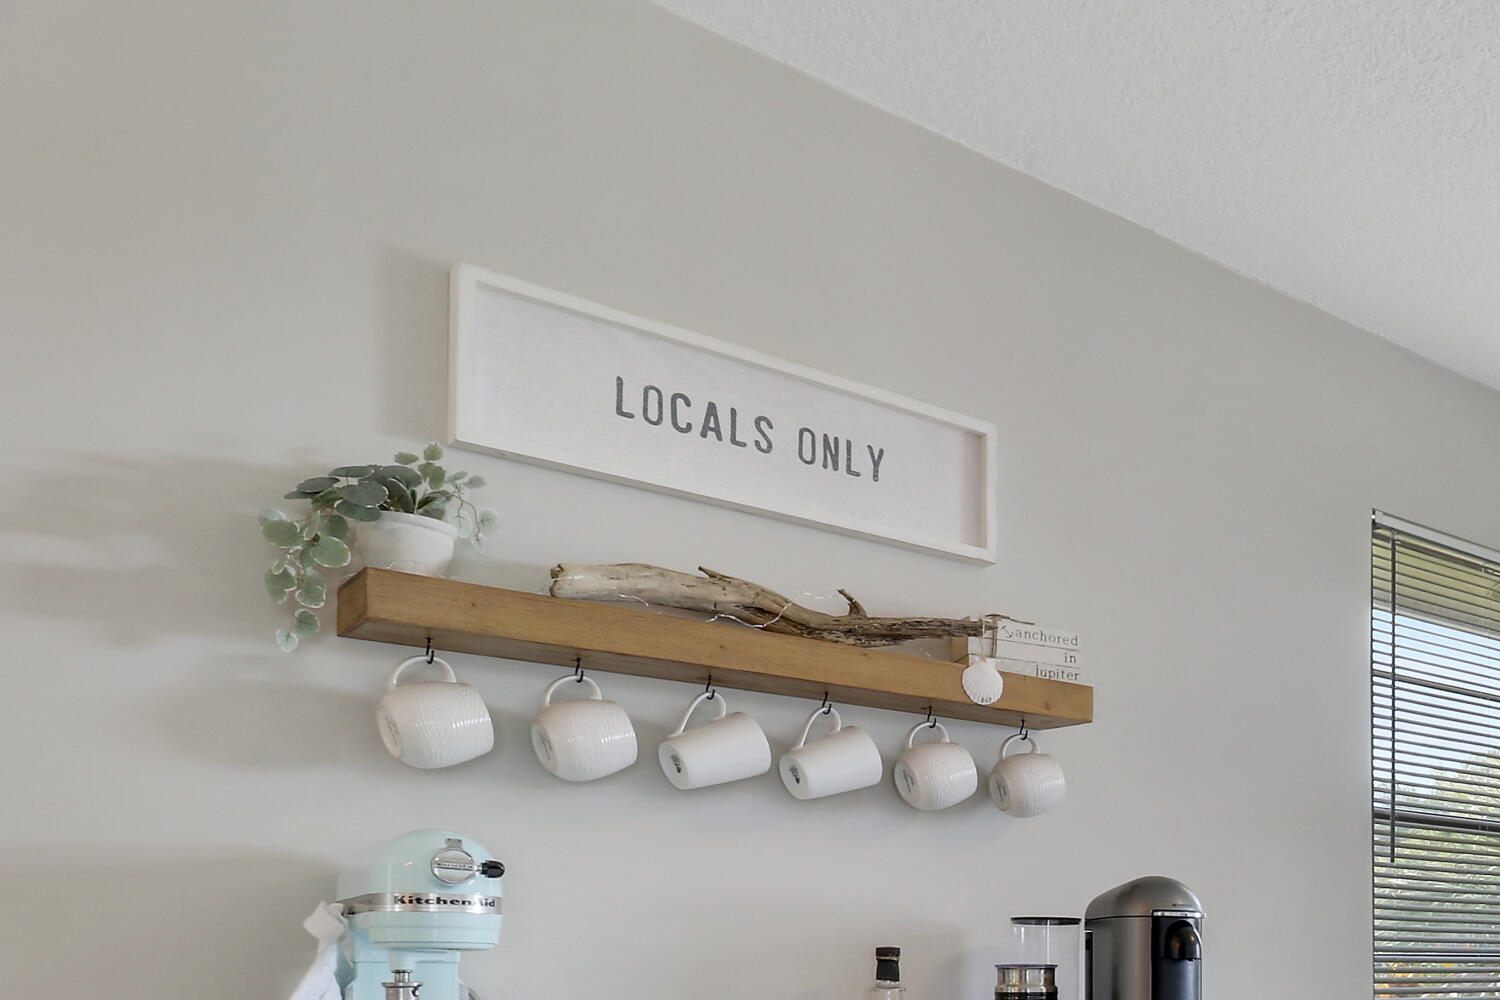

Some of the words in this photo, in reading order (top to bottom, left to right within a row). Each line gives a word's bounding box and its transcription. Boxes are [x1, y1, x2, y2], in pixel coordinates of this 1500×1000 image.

[615, 376, 774, 454] LOCALS
[798, 427, 884, 482] ONLY
[1015, 630, 1079, 646] anchored
[1064, 653, 1077, 663] in
